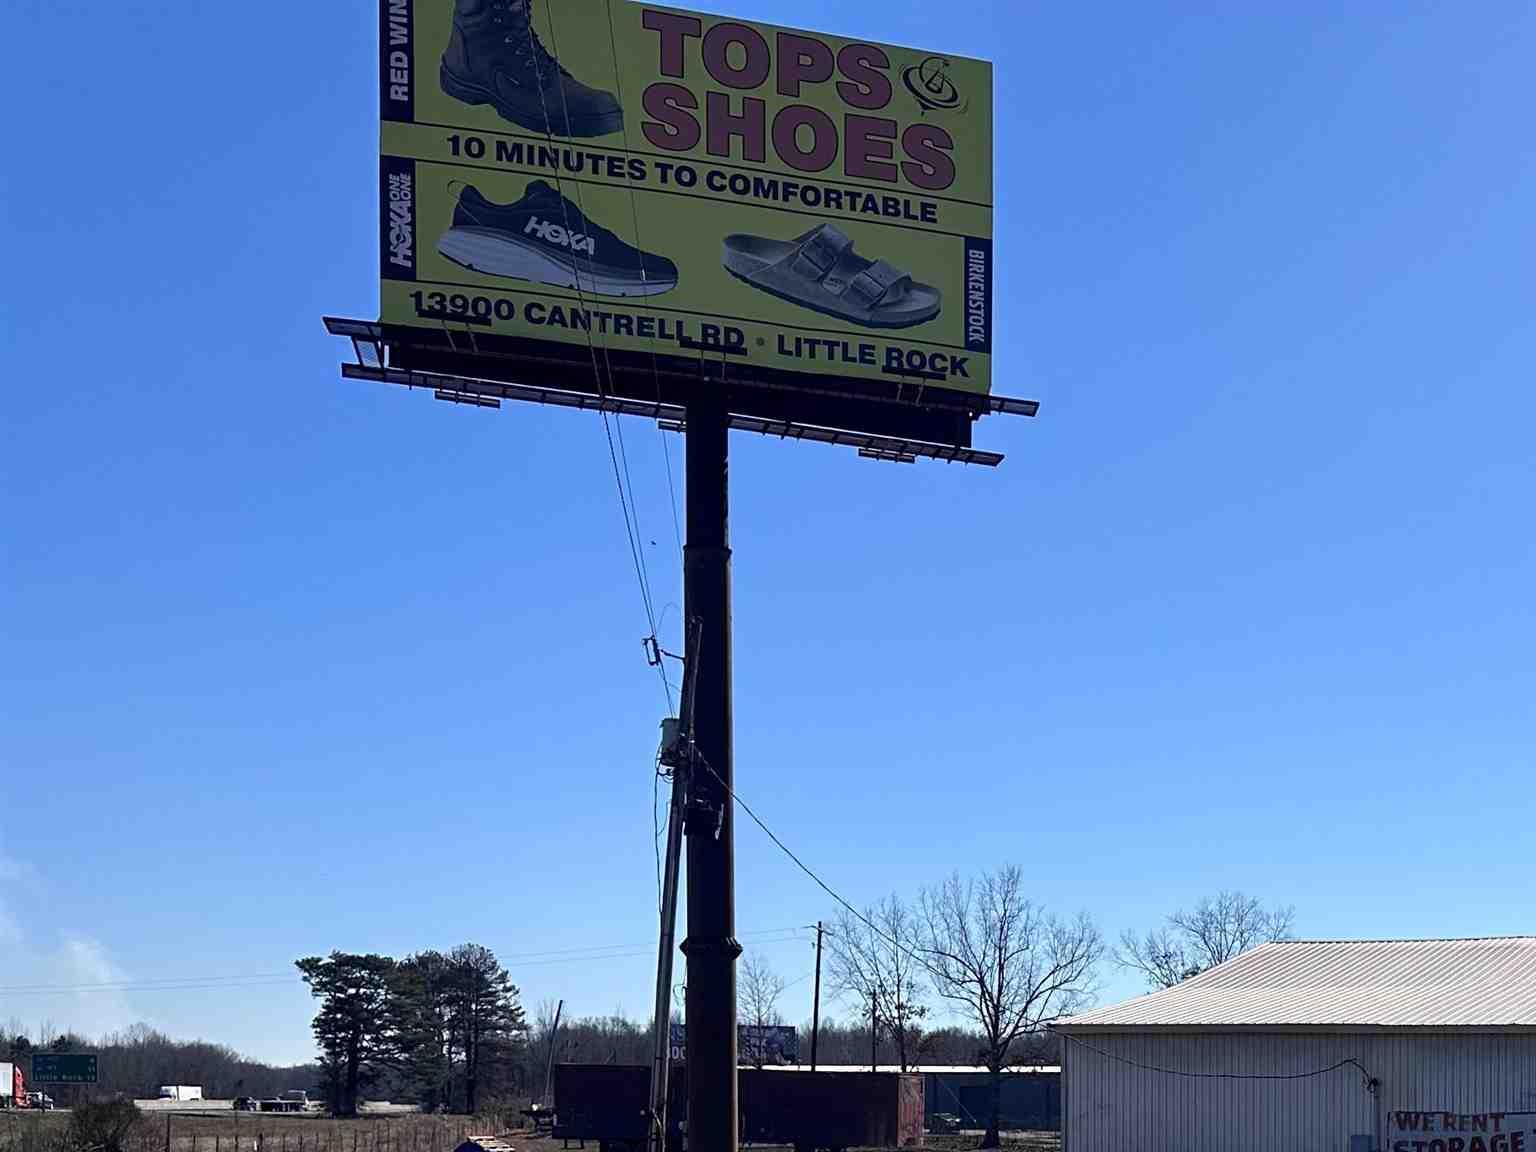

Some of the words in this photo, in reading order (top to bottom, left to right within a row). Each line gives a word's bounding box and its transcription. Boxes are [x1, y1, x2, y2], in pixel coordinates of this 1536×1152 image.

[389, 51, 409, 102] RED
[642, 9, 892, 110] TOPS
[447, 134, 485, 157] 10
[496, 140, 647, 180] MINUTES
[655, 162, 697, 188] TO
[706, 171, 937, 223] COMFORTABLE
[641, 82, 955, 191] SHOES
[523, 215, 595, 256] HOKA
[409, 290, 515, 321] 13900
[524, 302, 694, 343] CANTRELL
[701, 323, 745, 350] RD
[777, 334, 876, 365] LITTLE
[885, 350, 971, 378] ROCK
[968, 249, 985, 344] BIRKENSTOCK
[1395, 1112, 1436, 1132] WE
[1442, 1112, 1505, 1133] RENT
